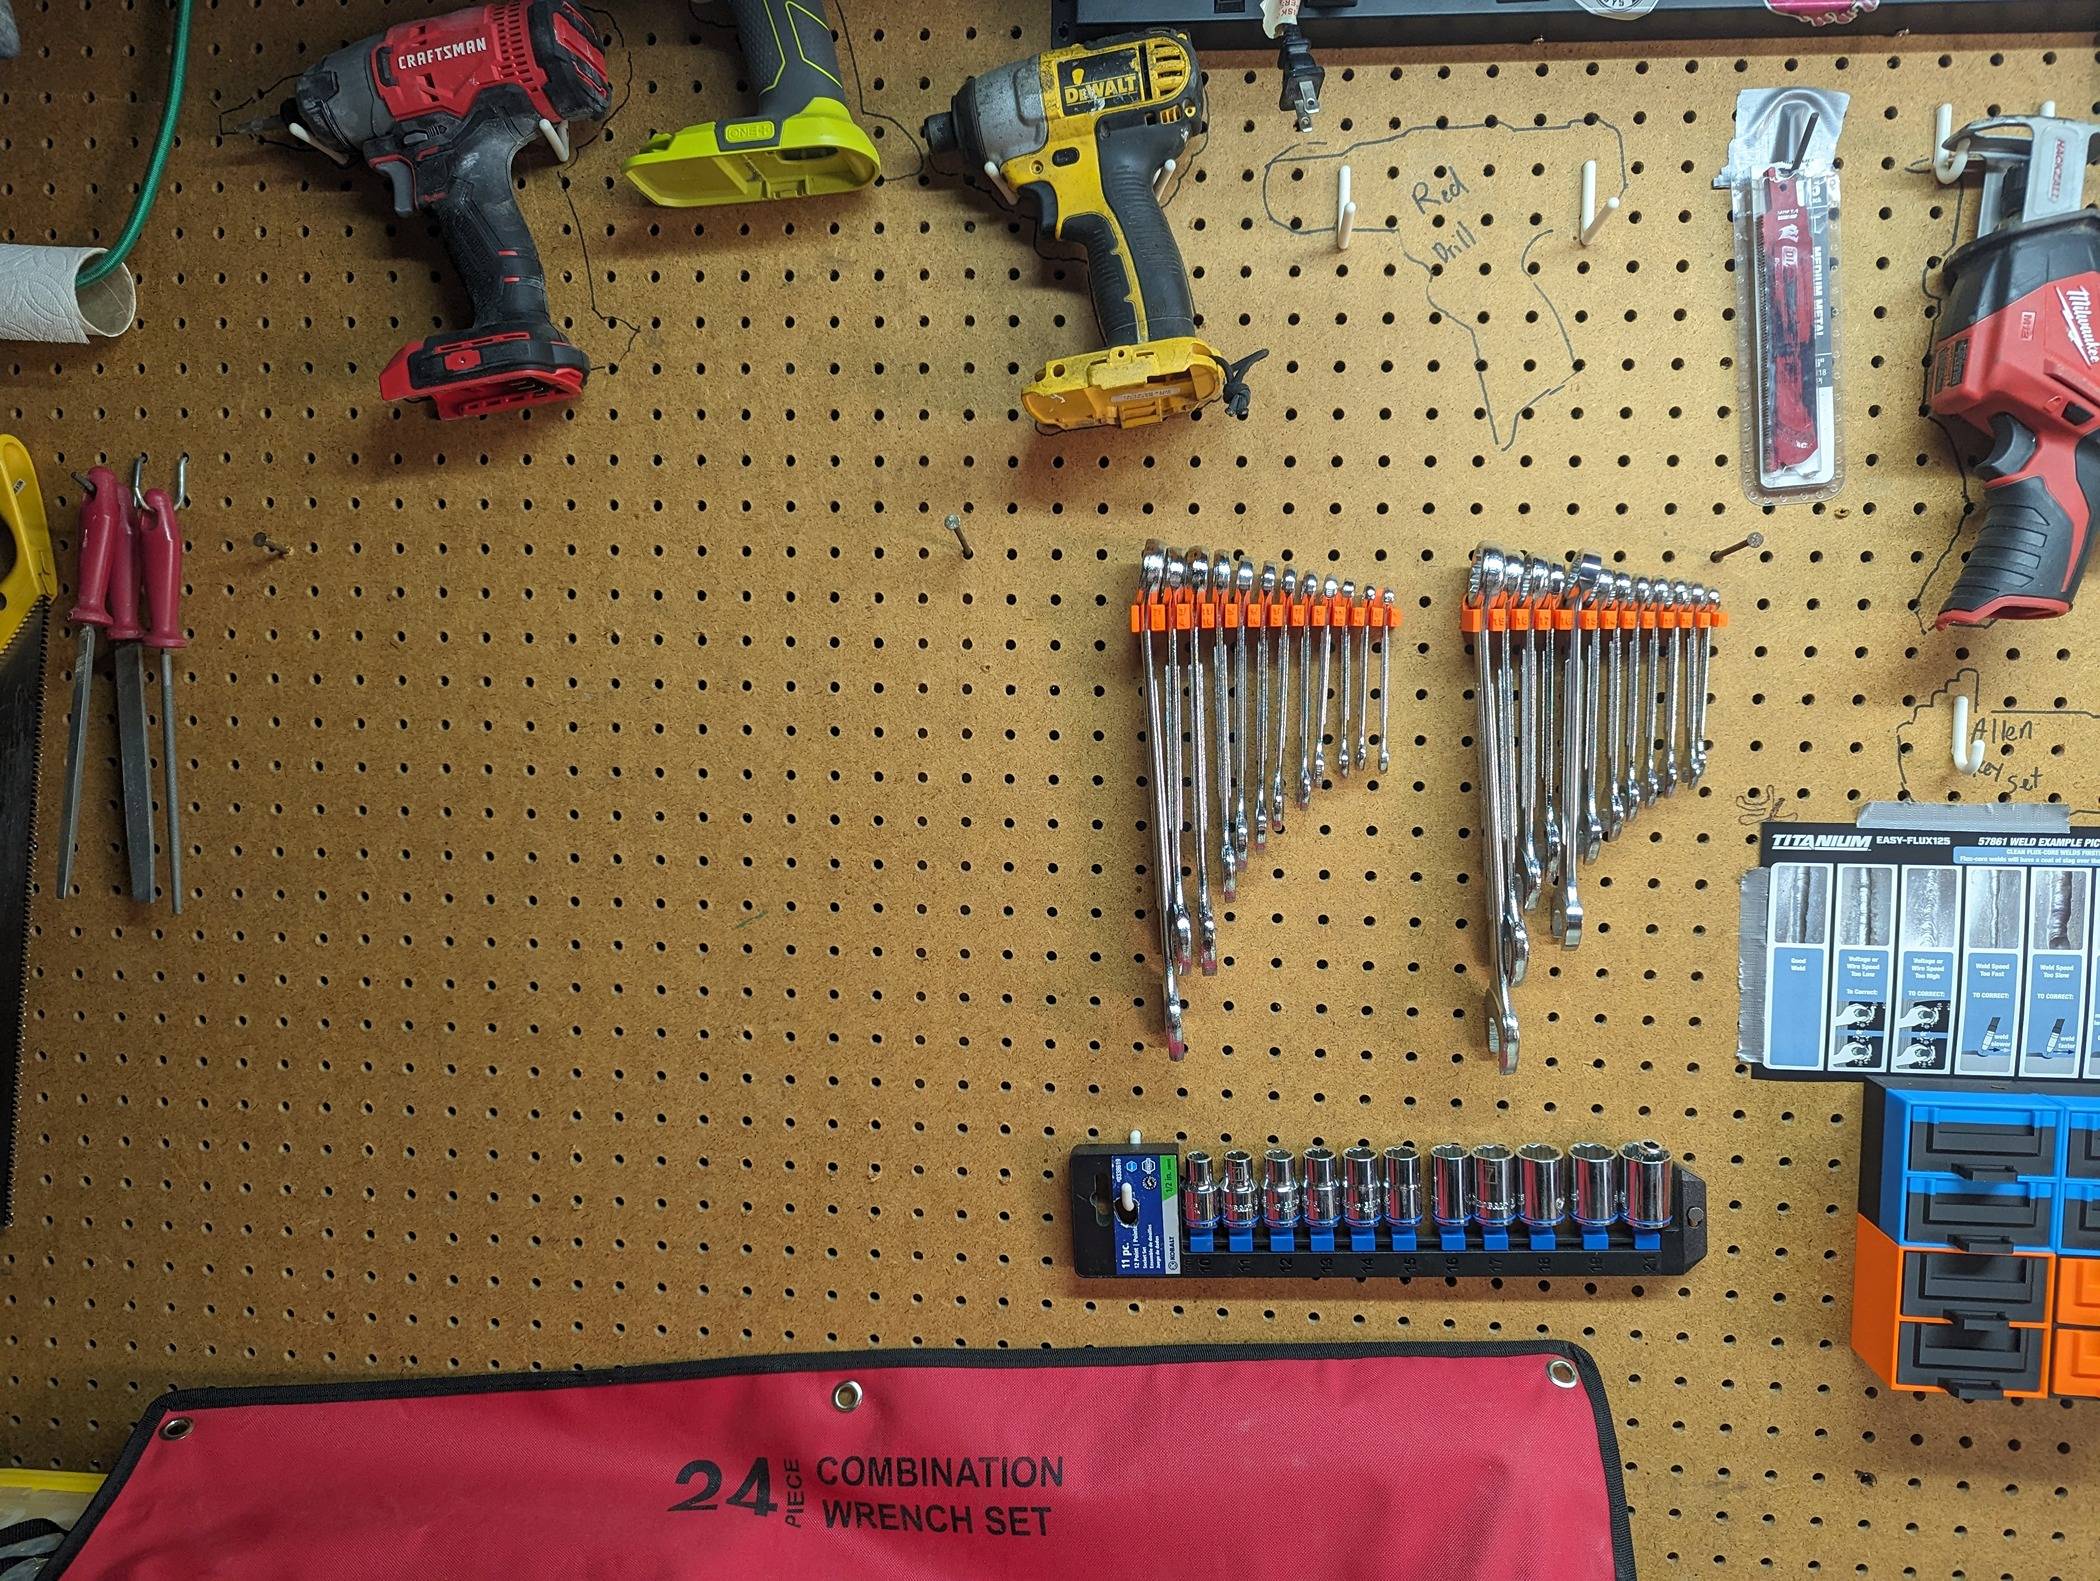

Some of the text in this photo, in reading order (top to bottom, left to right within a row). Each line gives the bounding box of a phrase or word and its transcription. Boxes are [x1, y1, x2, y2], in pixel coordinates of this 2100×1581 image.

[397, 37, 487, 69] CRAFTSMAN
[1411, 165, 1470, 215] Red
[1431, 221, 1477, 264] Drill
[1814, 246, 1823, 296] MEDIUM
[2066, 285, 2100, 364] Milwaukee
[1970, 717, 2033, 744] Allen
[1772, 834, 1951, 849] TITANIUM EASY-FLUX125
[1978, 837, 2007, 846] 57861
[2010, 837, 2036, 846] WELD
[2038, 838, 2083, 847] EXAMPLE
[2055, 964, 2074, 972] Speed
[1164, 1172, 1172, 1181] in.
[1165, 1182, 1173, 1193] 1/2
[1122, 1242, 1132, 1269] 11 pc.
[1168, 1236, 1176, 1261] KOBALT
[1279, 1257, 1294, 1273] 12
[1320, 1257, 1334, 1273] 13
[816, 1454, 1064, 1489] COMBINATION
[667, 1456, 779, 1518] 24
[783, 1458, 806, 1528] PIECE
[822, 1498, 1052, 1537] WRENCH SET
